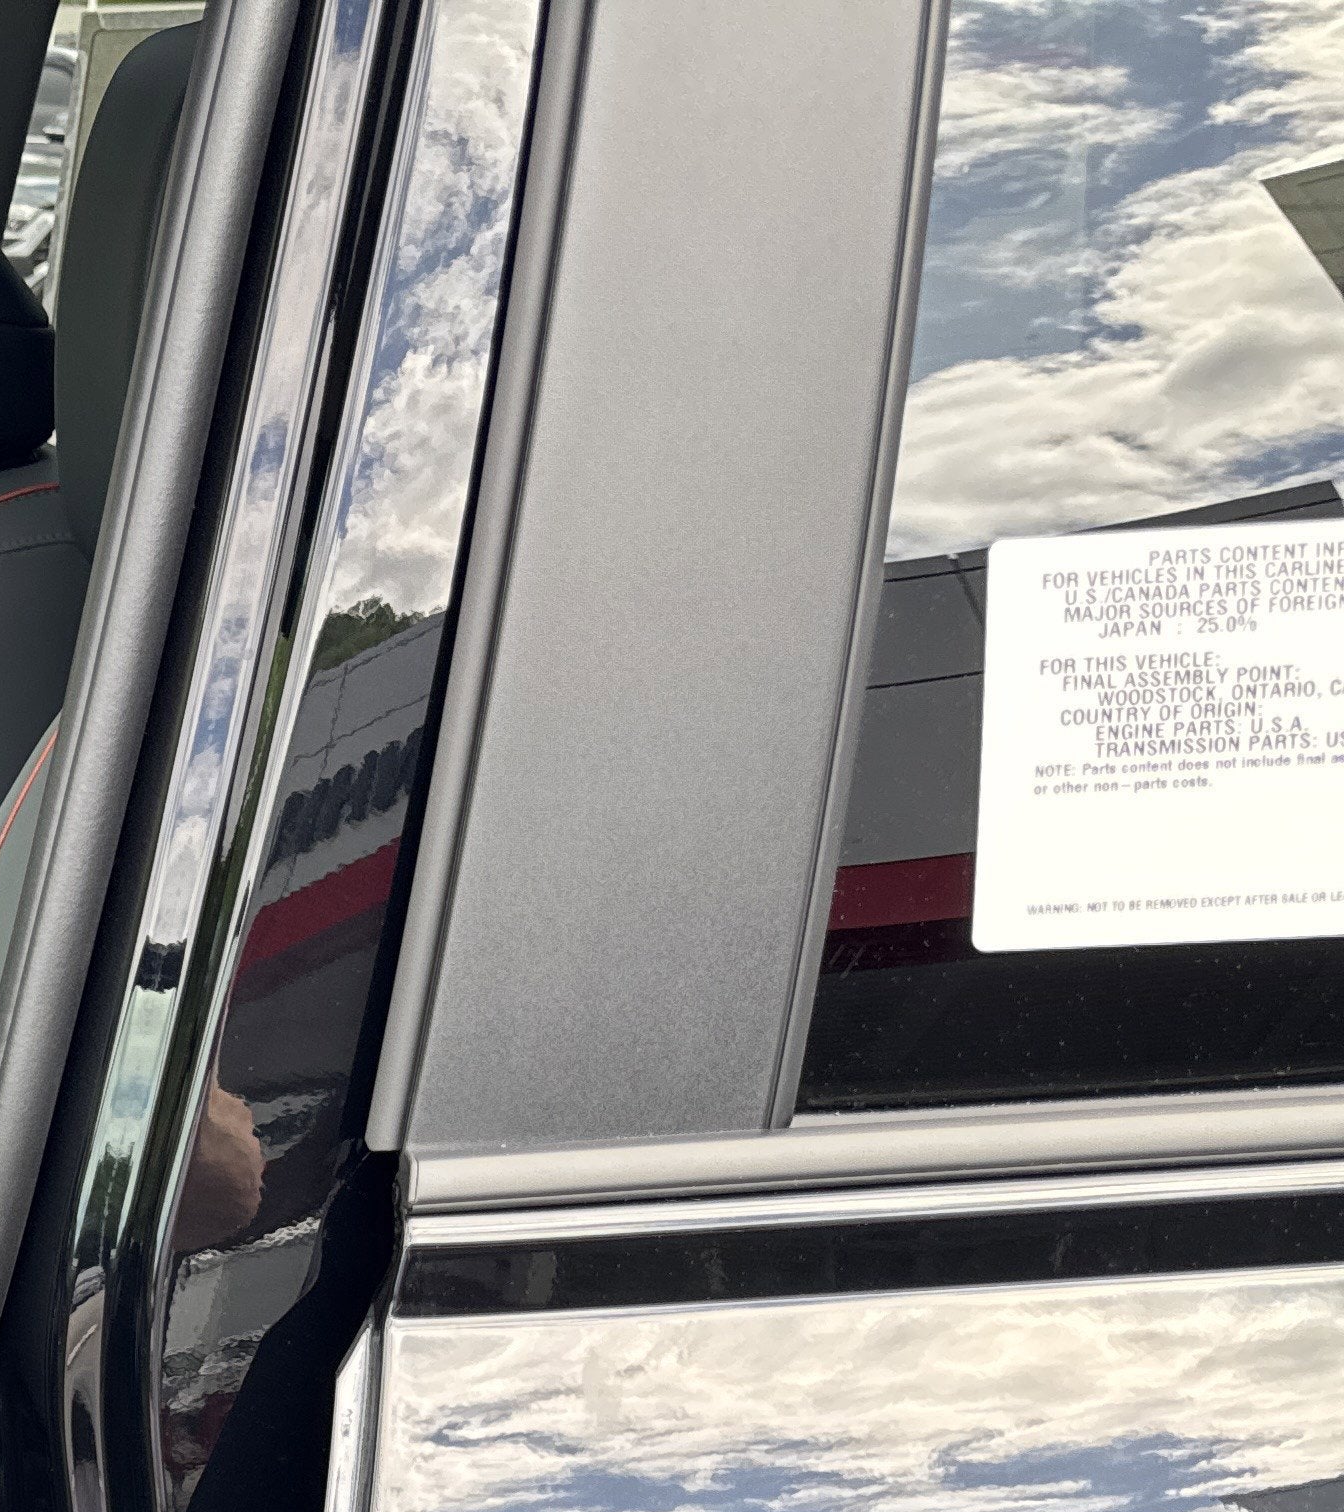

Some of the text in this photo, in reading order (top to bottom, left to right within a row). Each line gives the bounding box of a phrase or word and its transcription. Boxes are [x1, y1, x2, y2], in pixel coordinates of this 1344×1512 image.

[1149, 548, 1211, 566] PARTS
[1220, 543, 1308, 563] CONTENT
[1043, 573, 1078, 590] FOR
[1088, 567, 1178, 587] VEHICLES
[1186, 567, 1205, 581] IN
[1215, 563, 1256, 580] THIS
[1199, 580, 1261, 597] PARTS
[1064, 605, 1131, 623] MAJOR
[1140, 599, 1227, 620] SOURCES
[1237, 597, 1260, 614] OF
[1099, 621, 1162, 639] JAPAN
[1196, 616, 1257, 634] 25.0%
[1040, 651, 1221, 675] FOR THIS VEHICLE:
[1063, 665, 1300, 692] FINAL ASSEMBLY POINT:
[1232, 680, 1323, 701] ONTARIO,
[1061, 702, 1263, 726] COUNTRY OF ORIGIN:
[1096, 722, 1164, 741] ENGINE
[1173, 720, 1242, 737] PARTS:
[1096, 732, 1318, 758] TRANSMISSION PARTS:
[1035, 764, 1075, 778] NOTE:
[1083, 762, 1116, 776] Parts
[1121, 760, 1173, 774] content
[1178, 758, 1209, 771] does
[1216, 757, 1237, 770] not
[1242, 754, 1291, 768] include
[1297, 753, 1326, 765] final
[1033, 783, 1048, 795] or
[1053, 781, 1088, 794] other
[1173, 775, 1212, 789] costs.
[1028, 903, 1082, 915] WARNING:
[1087, 902, 1108, 913] NOT
[1112, 901, 1125, 911] TO
[1129, 899, 1142, 911] BE
[1146, 897, 1198, 911] REMOVED
[1201, 895, 1241, 908] EXCEPT
[1245, 893, 1278, 906] AFTER
[1311, 891, 1326, 902] OR
